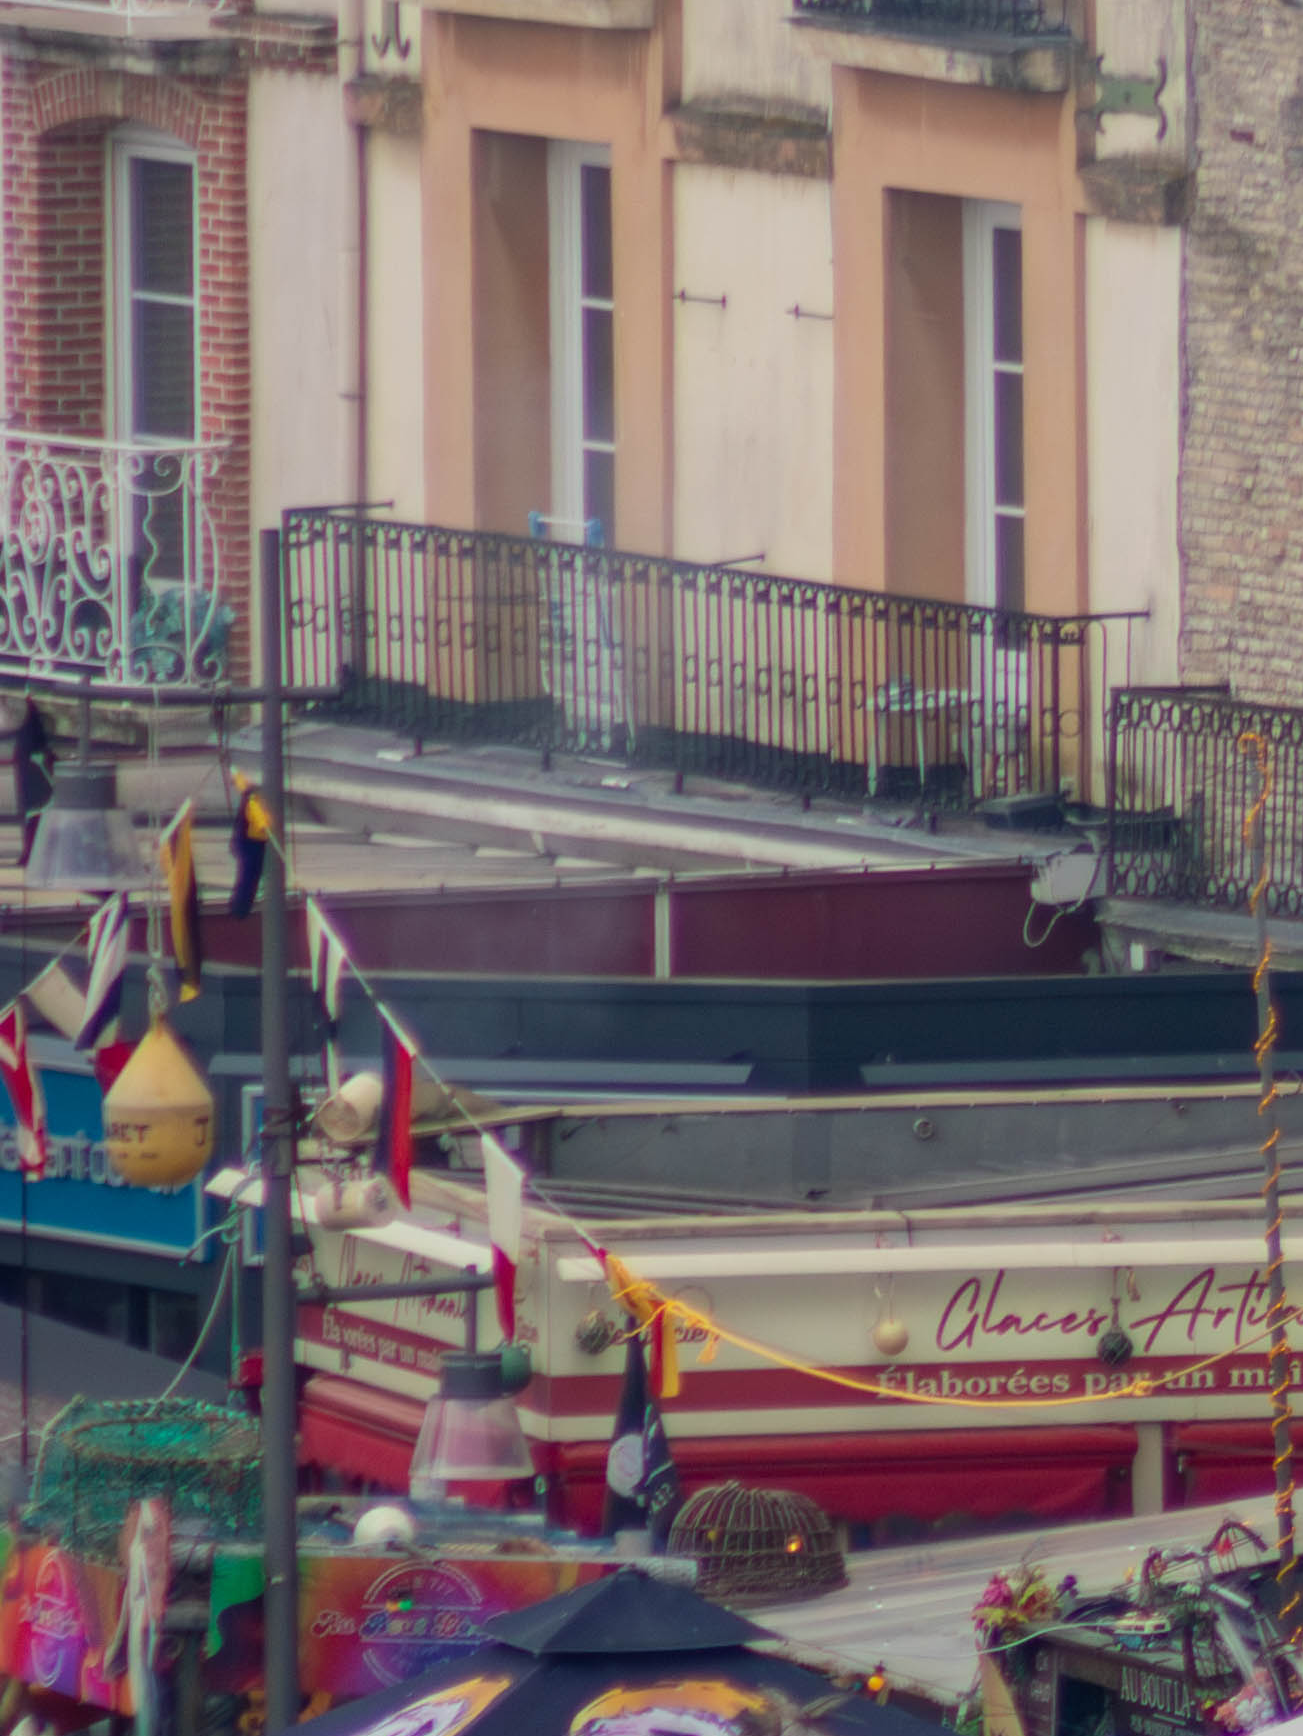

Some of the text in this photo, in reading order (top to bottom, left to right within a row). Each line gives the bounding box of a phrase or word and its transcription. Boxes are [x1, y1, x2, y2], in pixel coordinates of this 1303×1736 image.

[936, 1268, 1109, 1351] Glaces
[875, 1366, 1070, 1400] Élaborées
[1165, 1369, 1215, 1390] un
